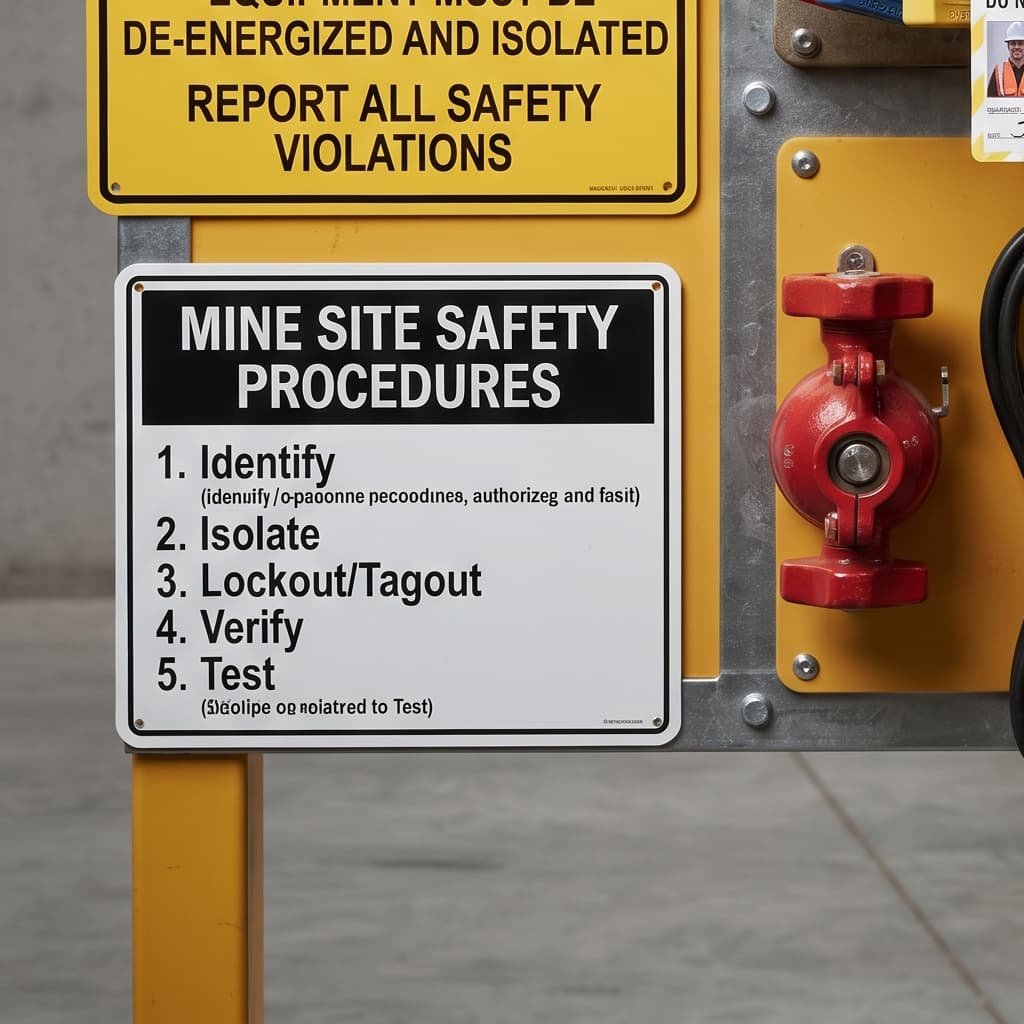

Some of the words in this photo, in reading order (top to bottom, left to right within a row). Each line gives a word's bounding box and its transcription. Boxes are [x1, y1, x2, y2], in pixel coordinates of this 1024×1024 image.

[124, 20, 392, 56] DE-ENERGIZED
[403, 21, 479, 55] AND
[493, 20, 668, 56] ISOLATED
[189, 84, 348, 122] REPORT
[360, 84, 435, 121] ALL
[448, 84, 601, 122] SAFETY
[275, 133, 511, 172] VIOLATIONS
[182, 306, 301, 350] MINE
[318, 306, 420, 350] SITE
[436, 305, 618, 350] SAFETY
[239, 363, 560, 409] PROCEDURES
[158, 445, 184, 479] 1.
[202, 444, 335, 487] Identify
[565, 487, 594, 502] and
[157, 517, 185, 550] 2.
[202, 516, 319, 550] Isolate
[158, 563, 186, 597] 3.
[203, 562, 481, 606] Lockout/Tagout
[156, 610, 185, 644] 4.
[200, 609, 303, 652] Verify
[158, 657, 186, 691] 5.
[201, 657, 275, 690] Test
[372, 700, 387, 714] to
[394, 698, 432, 718] Test)
